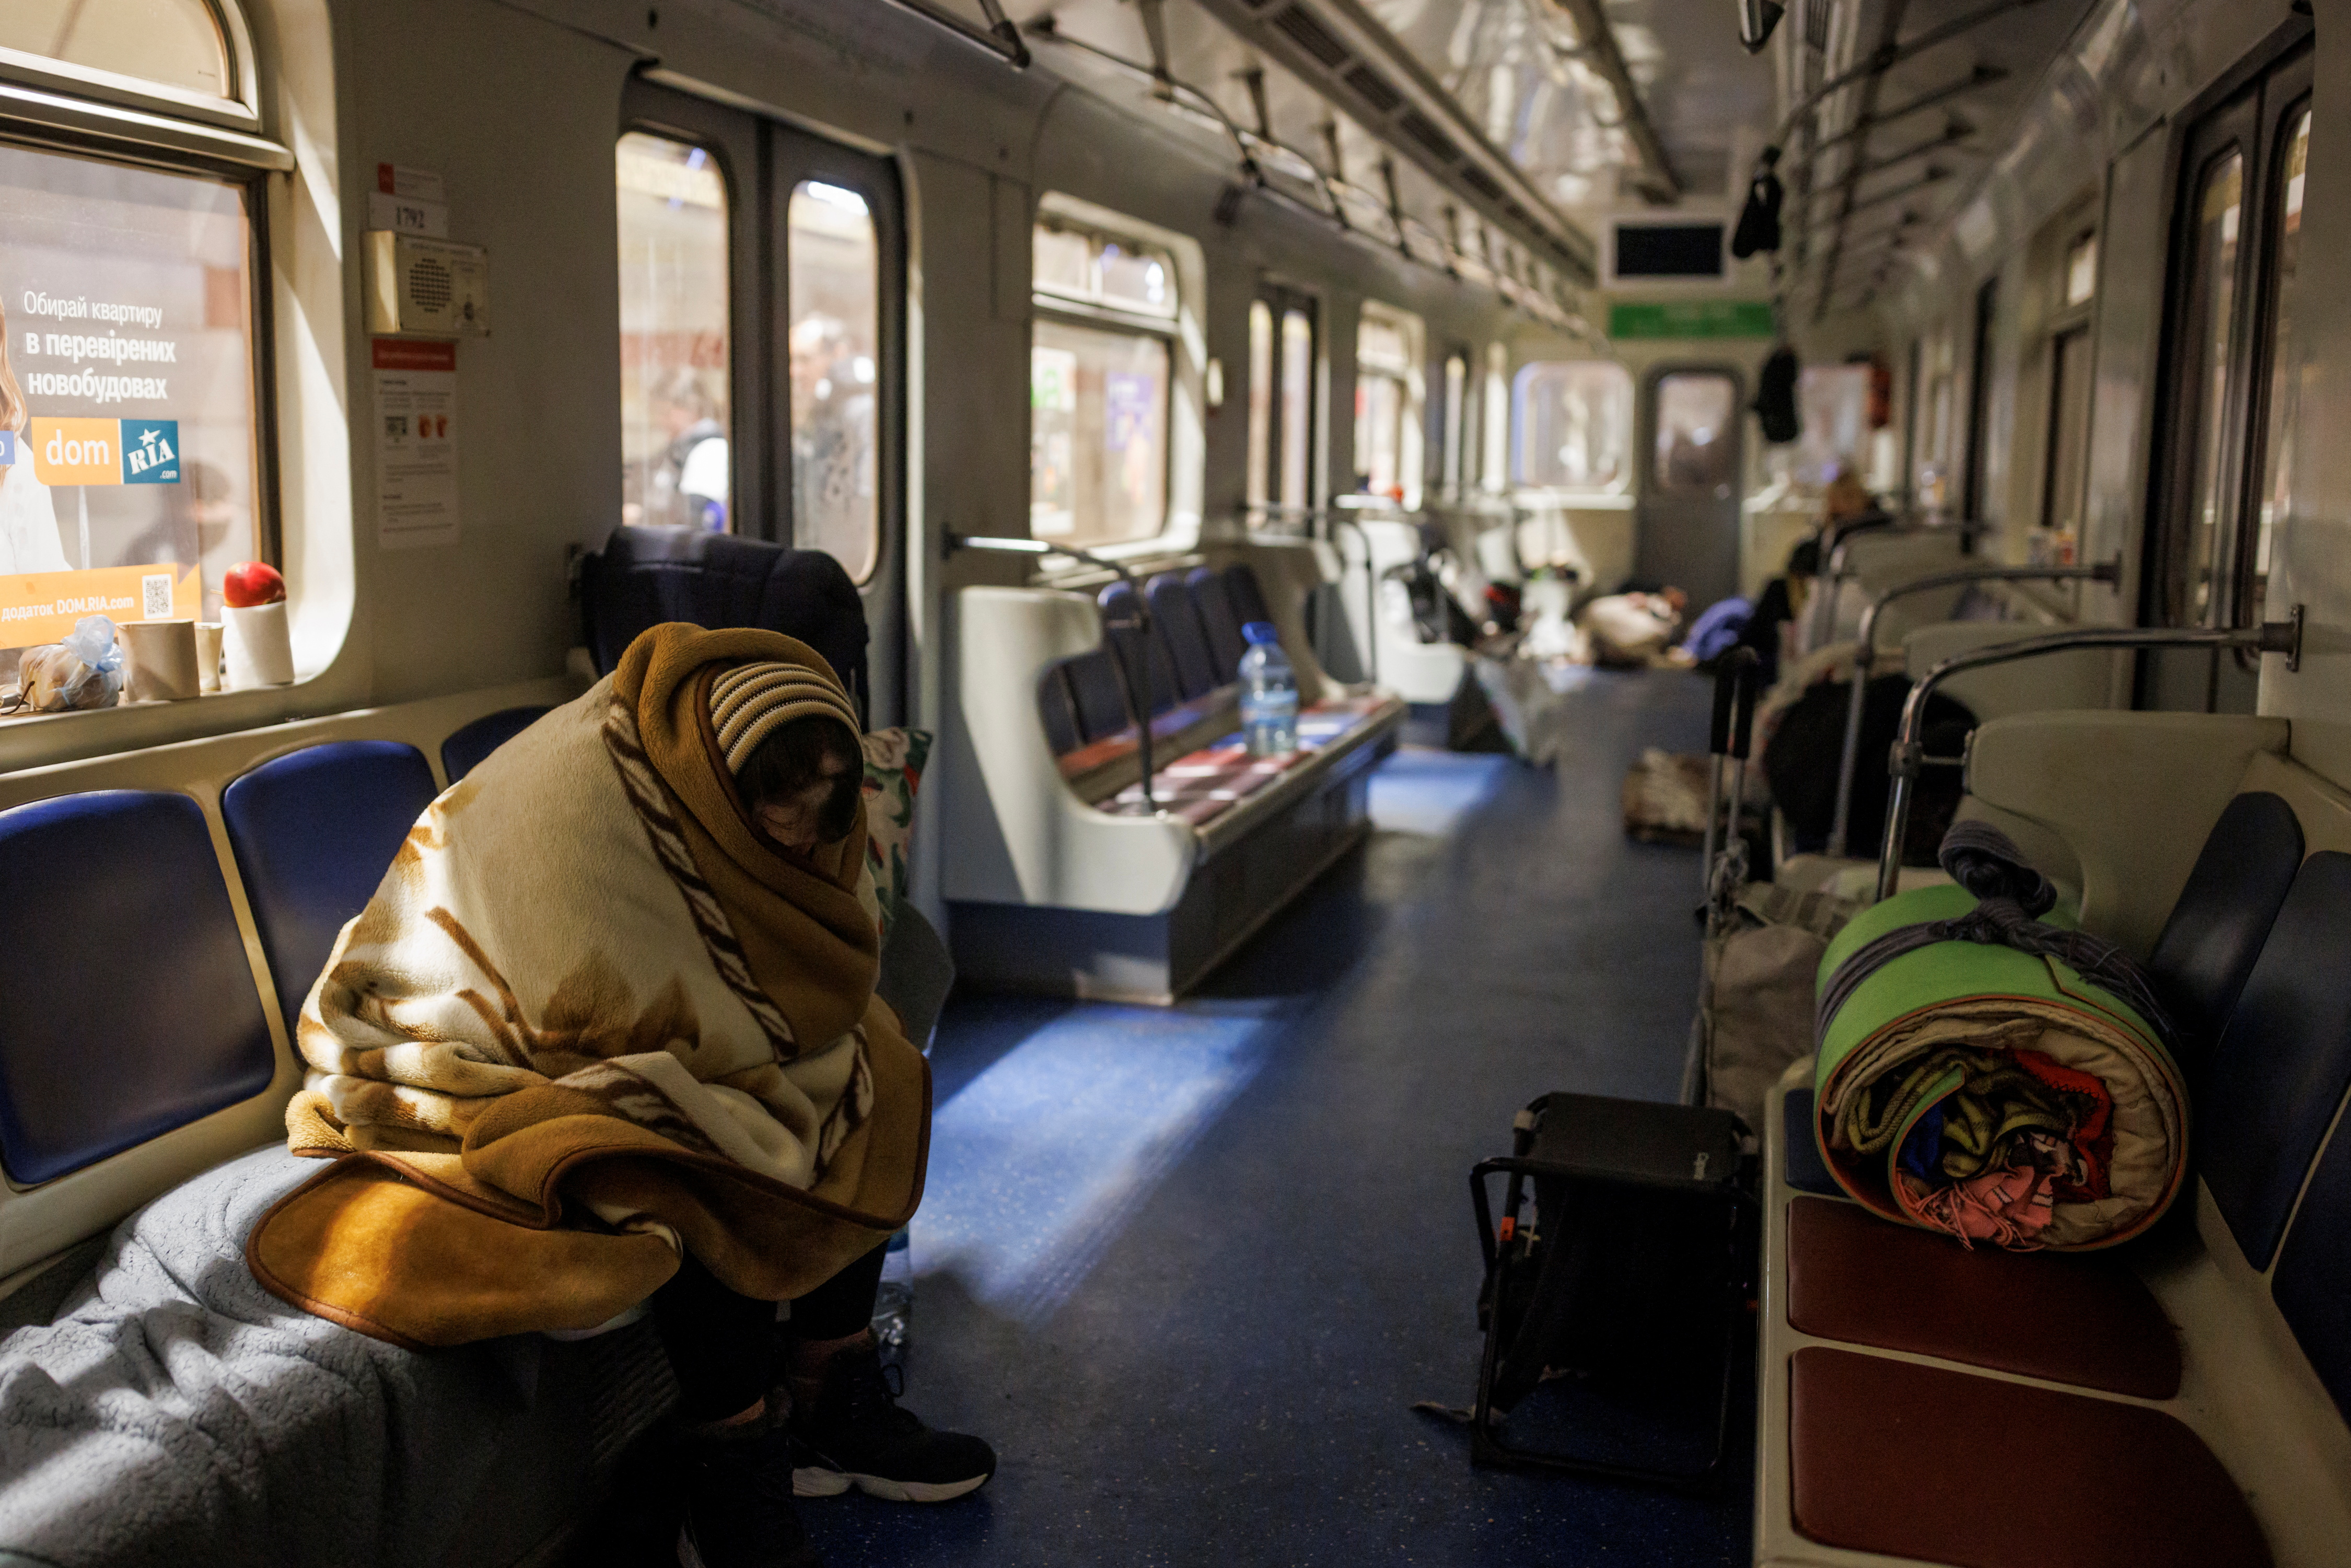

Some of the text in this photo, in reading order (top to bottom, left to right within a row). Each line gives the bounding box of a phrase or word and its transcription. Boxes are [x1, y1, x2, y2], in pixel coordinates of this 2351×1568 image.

[24, 291, 162, 329] Обирай квартиру
[26, 329, 177, 365] в перевірених
[28, 367, 168, 403] новобудовах
[45, 429, 109, 466] dom
[127, 438, 176, 475] RIA
[159, 470, 178, 480] .com
[1, 596, 134, 622] додаток DOM.RIA.com
